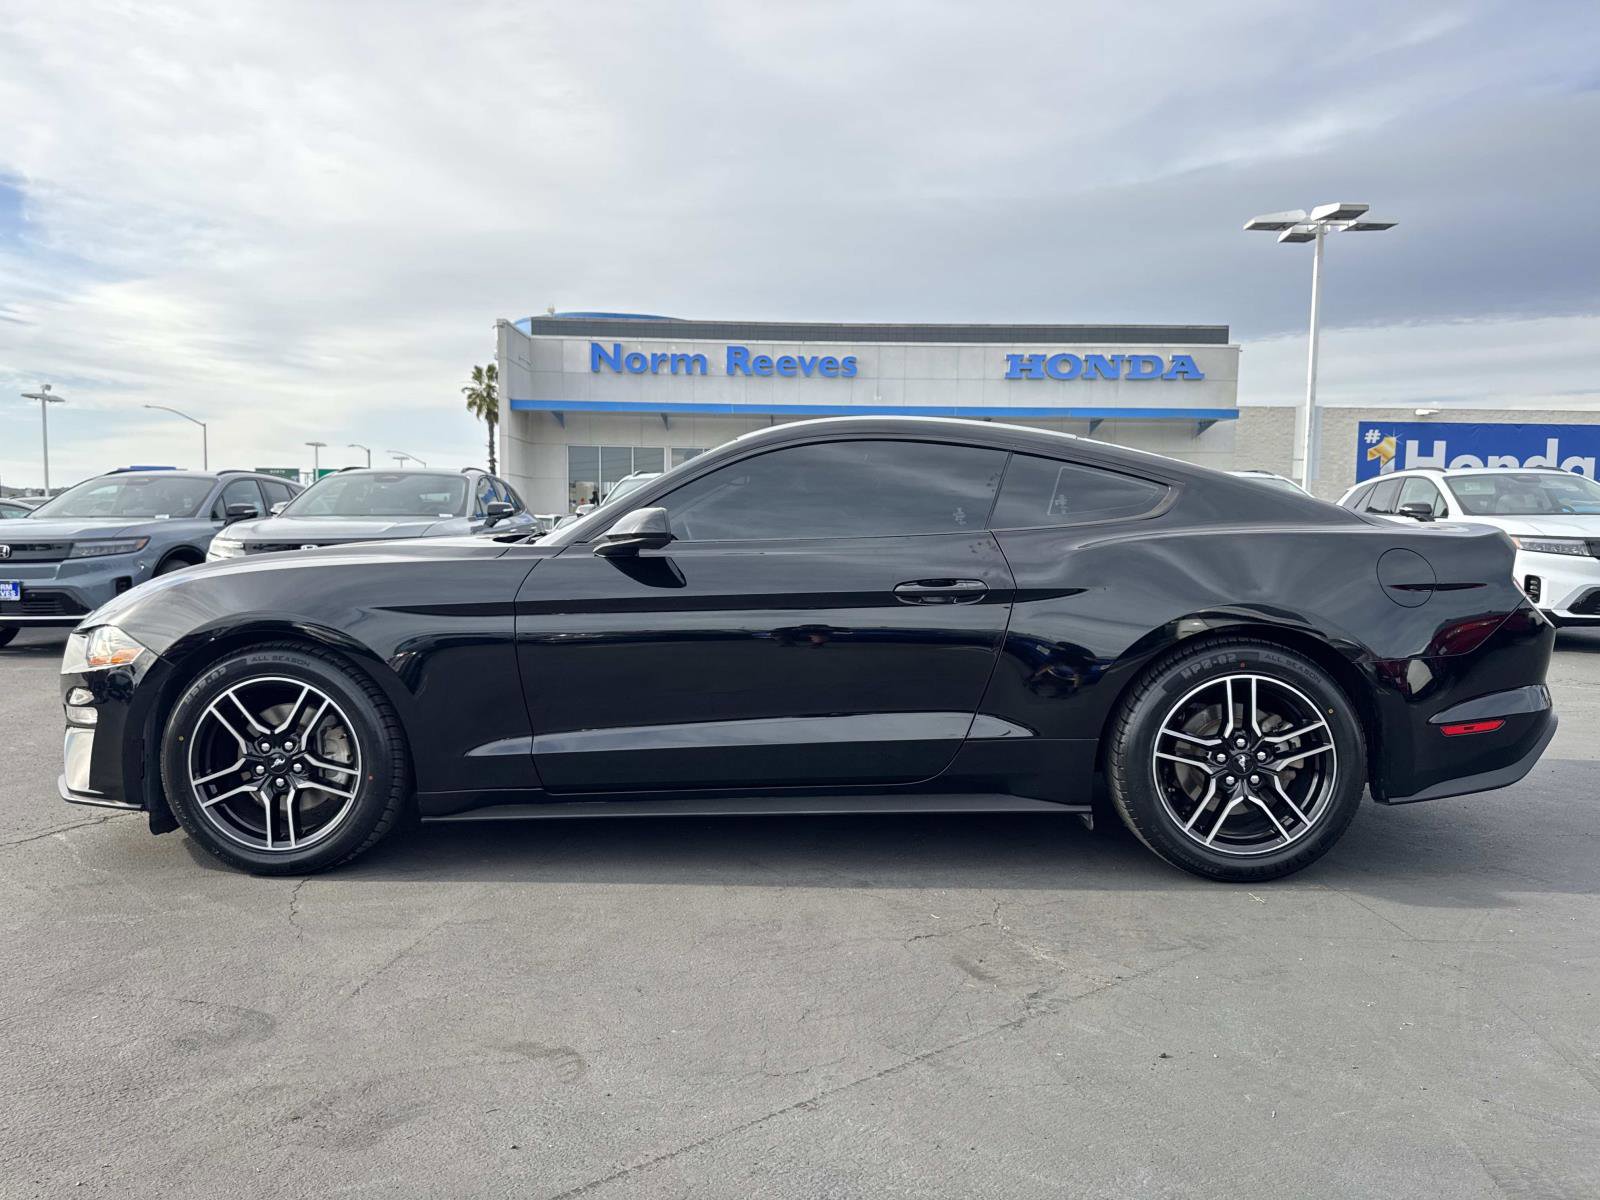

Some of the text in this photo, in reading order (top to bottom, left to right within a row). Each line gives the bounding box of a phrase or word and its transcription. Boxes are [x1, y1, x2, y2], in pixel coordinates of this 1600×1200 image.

[591, 342, 858, 378] Norm Reeves
[1004, 353, 1205, 380] HONDA
